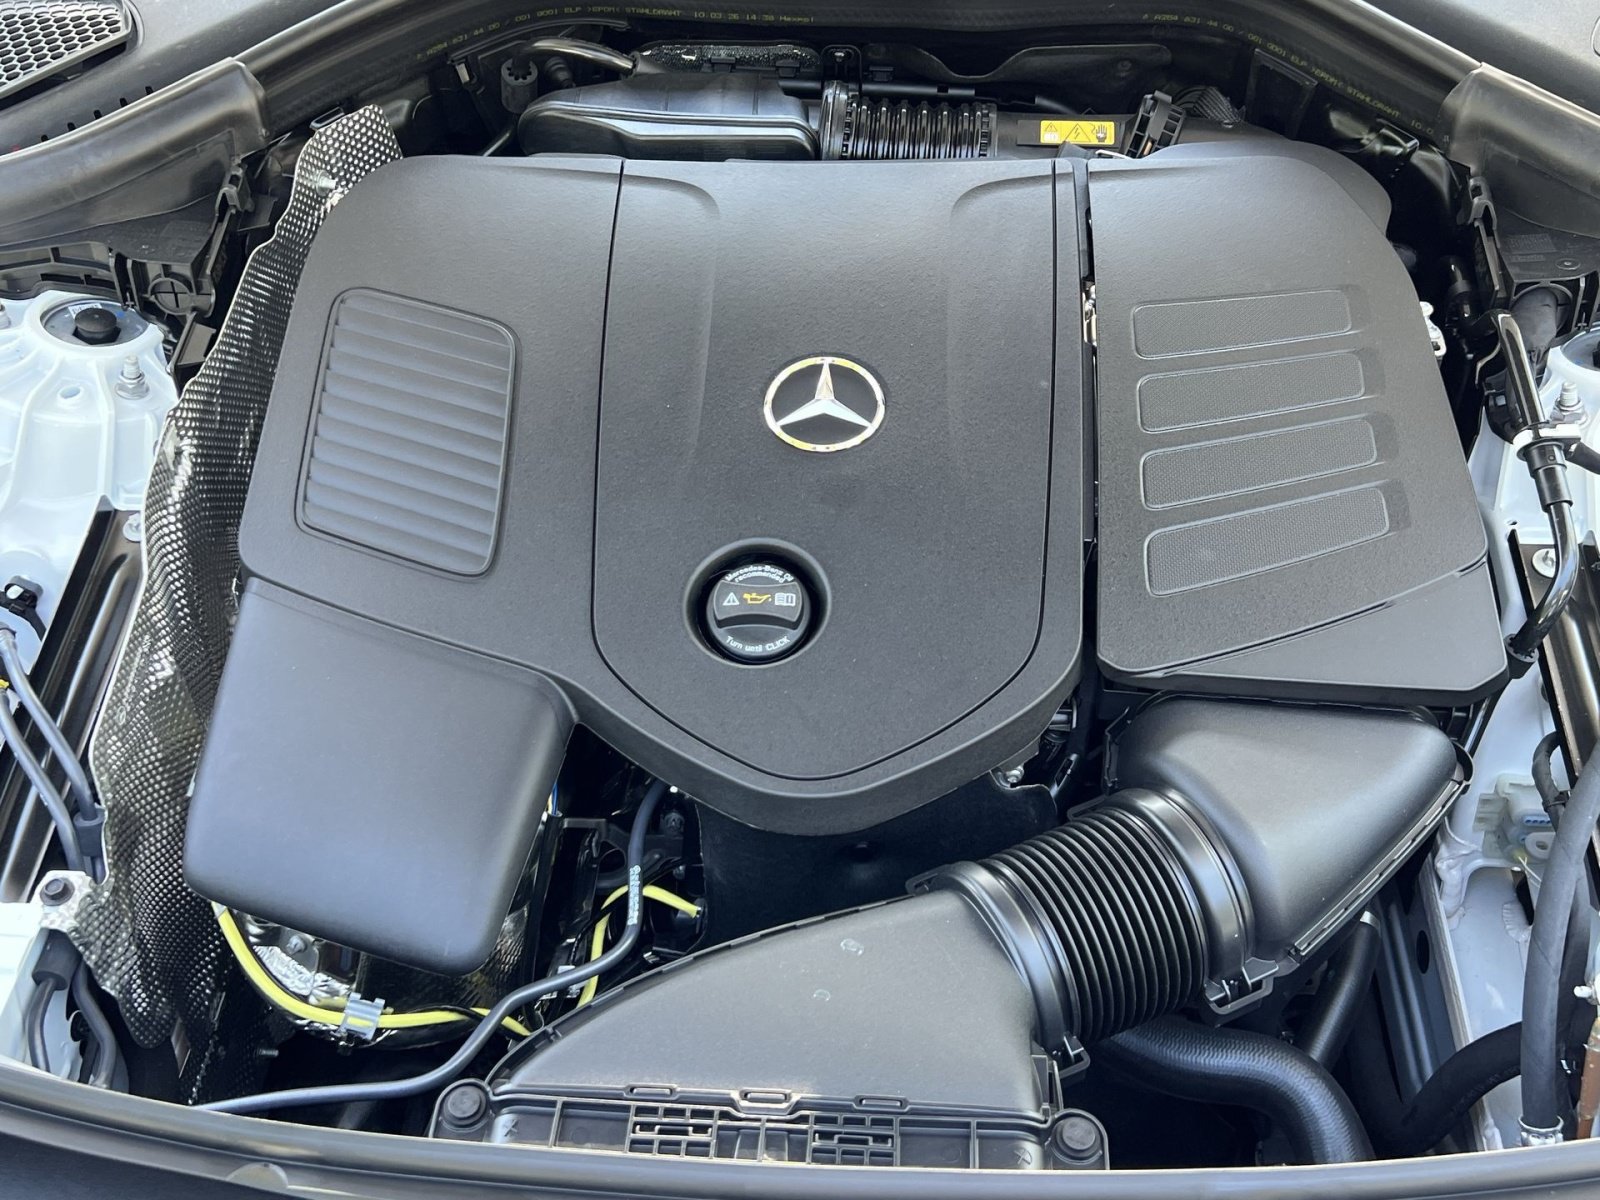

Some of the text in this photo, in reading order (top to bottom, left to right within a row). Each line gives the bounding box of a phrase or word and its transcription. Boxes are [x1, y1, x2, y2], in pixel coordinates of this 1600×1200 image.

[724, 564, 784, 581] Mercedes-Benz
[735, 571, 786, 583] recommended
[726, 635, 791, 653] Turn until CLICK
